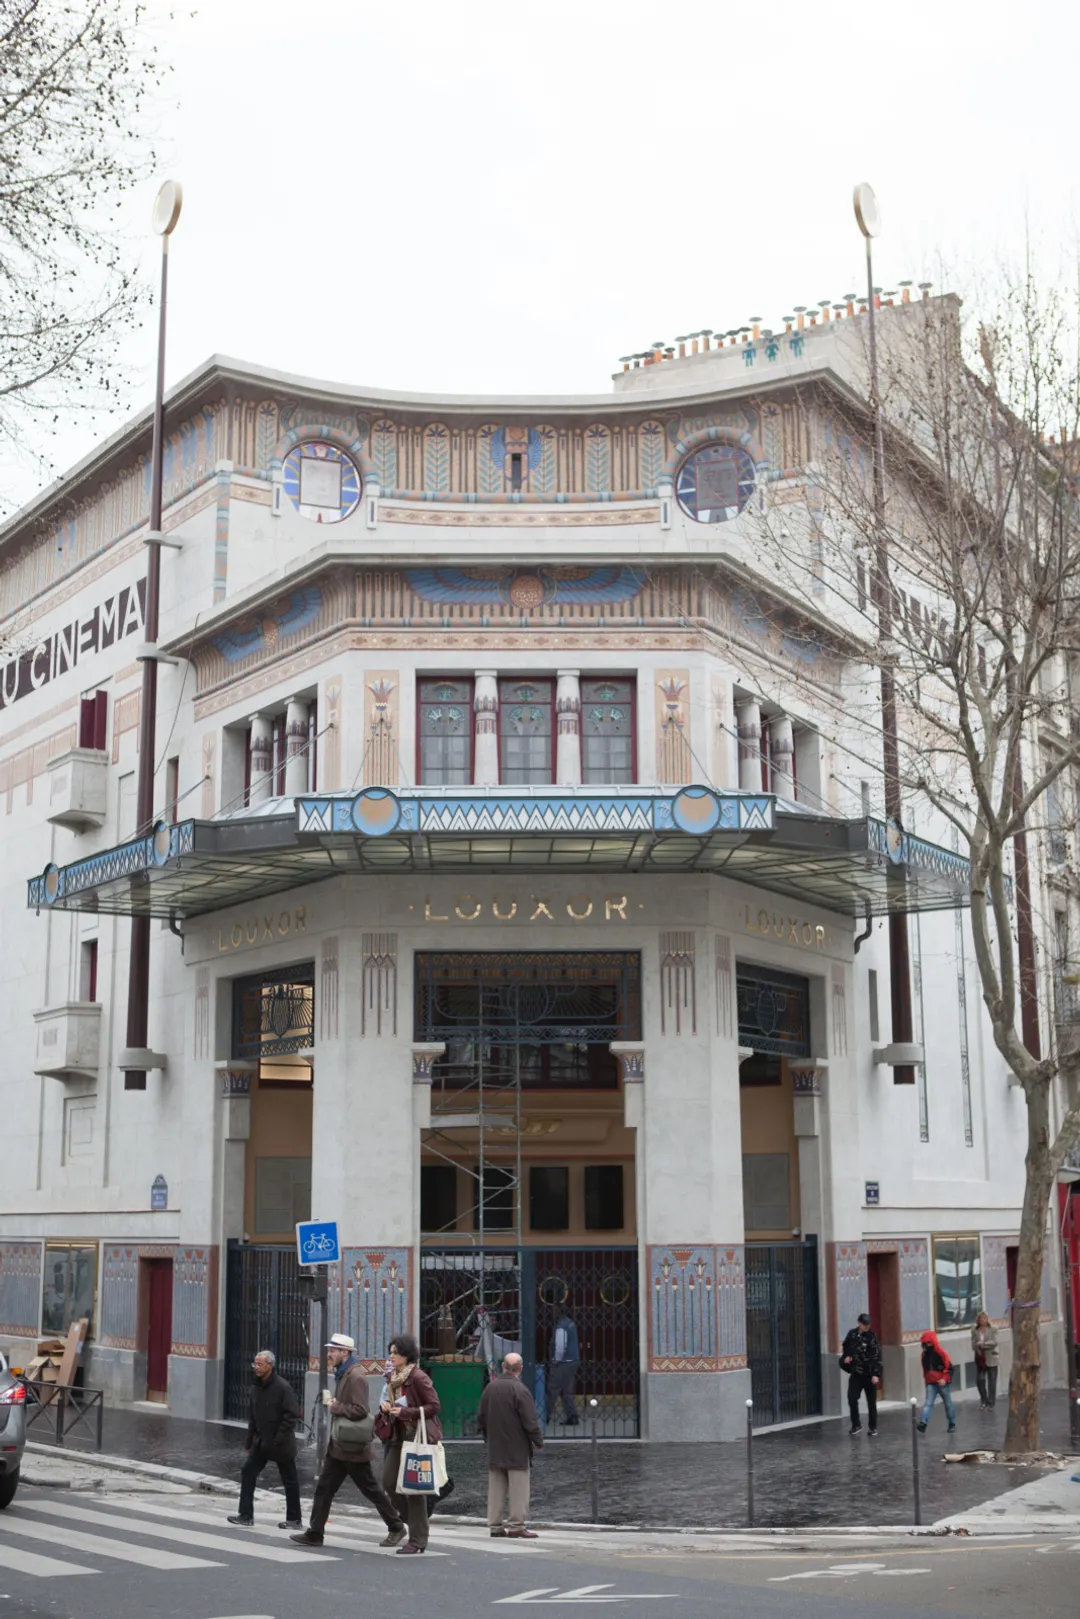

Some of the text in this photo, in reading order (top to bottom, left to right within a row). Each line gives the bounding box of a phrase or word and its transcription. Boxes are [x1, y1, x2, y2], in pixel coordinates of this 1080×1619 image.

[30, 582, 145, 690] CINEMA
[218, 904, 306, 951] LOUXOR
[425, 893, 628, 921] LOUXOR
[744, 904, 826, 949] LOUXOR
